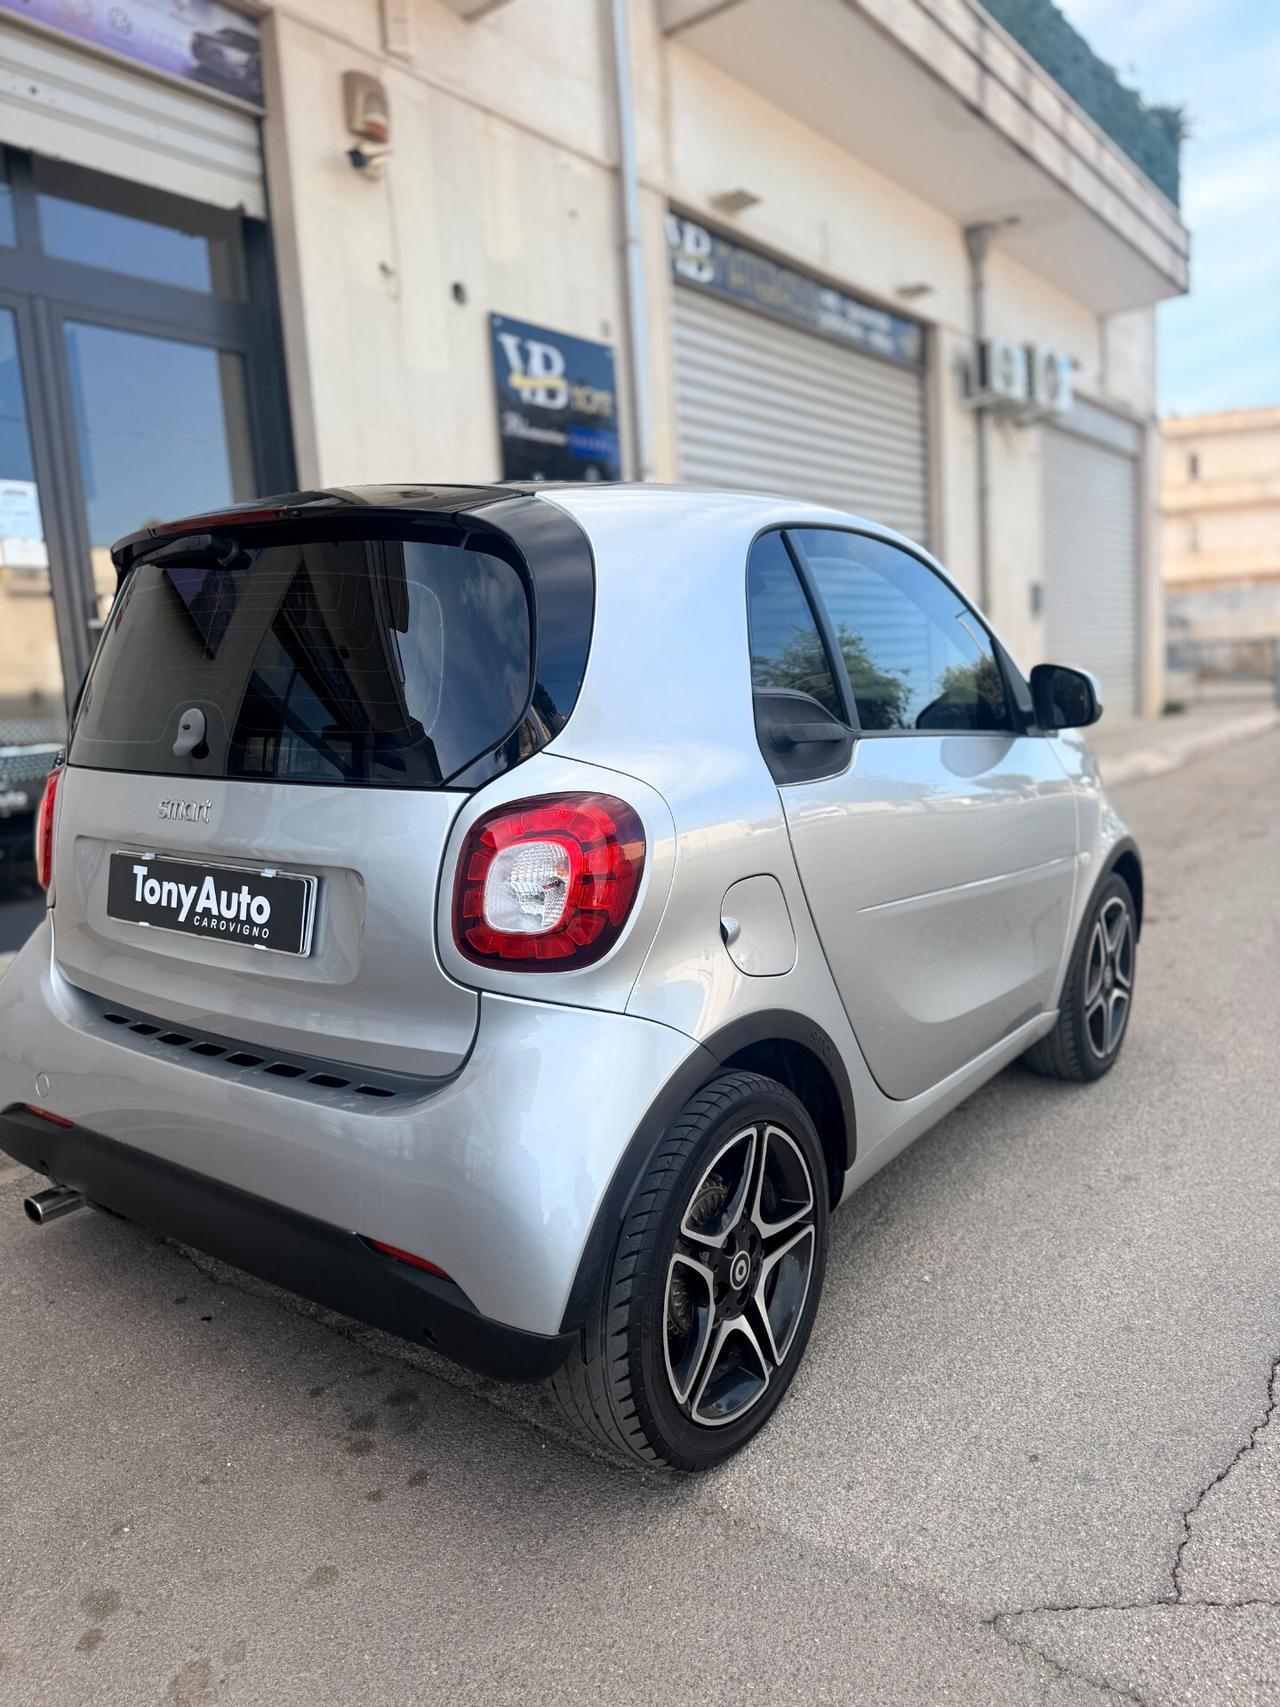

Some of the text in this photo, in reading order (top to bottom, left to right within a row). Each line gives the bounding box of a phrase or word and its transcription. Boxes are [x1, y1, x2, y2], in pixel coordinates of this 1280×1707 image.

[157, 797, 212, 823] smart
[132, 864, 271, 925] TonyAuto
[193, 915, 270, 939] CAROVIGNO
